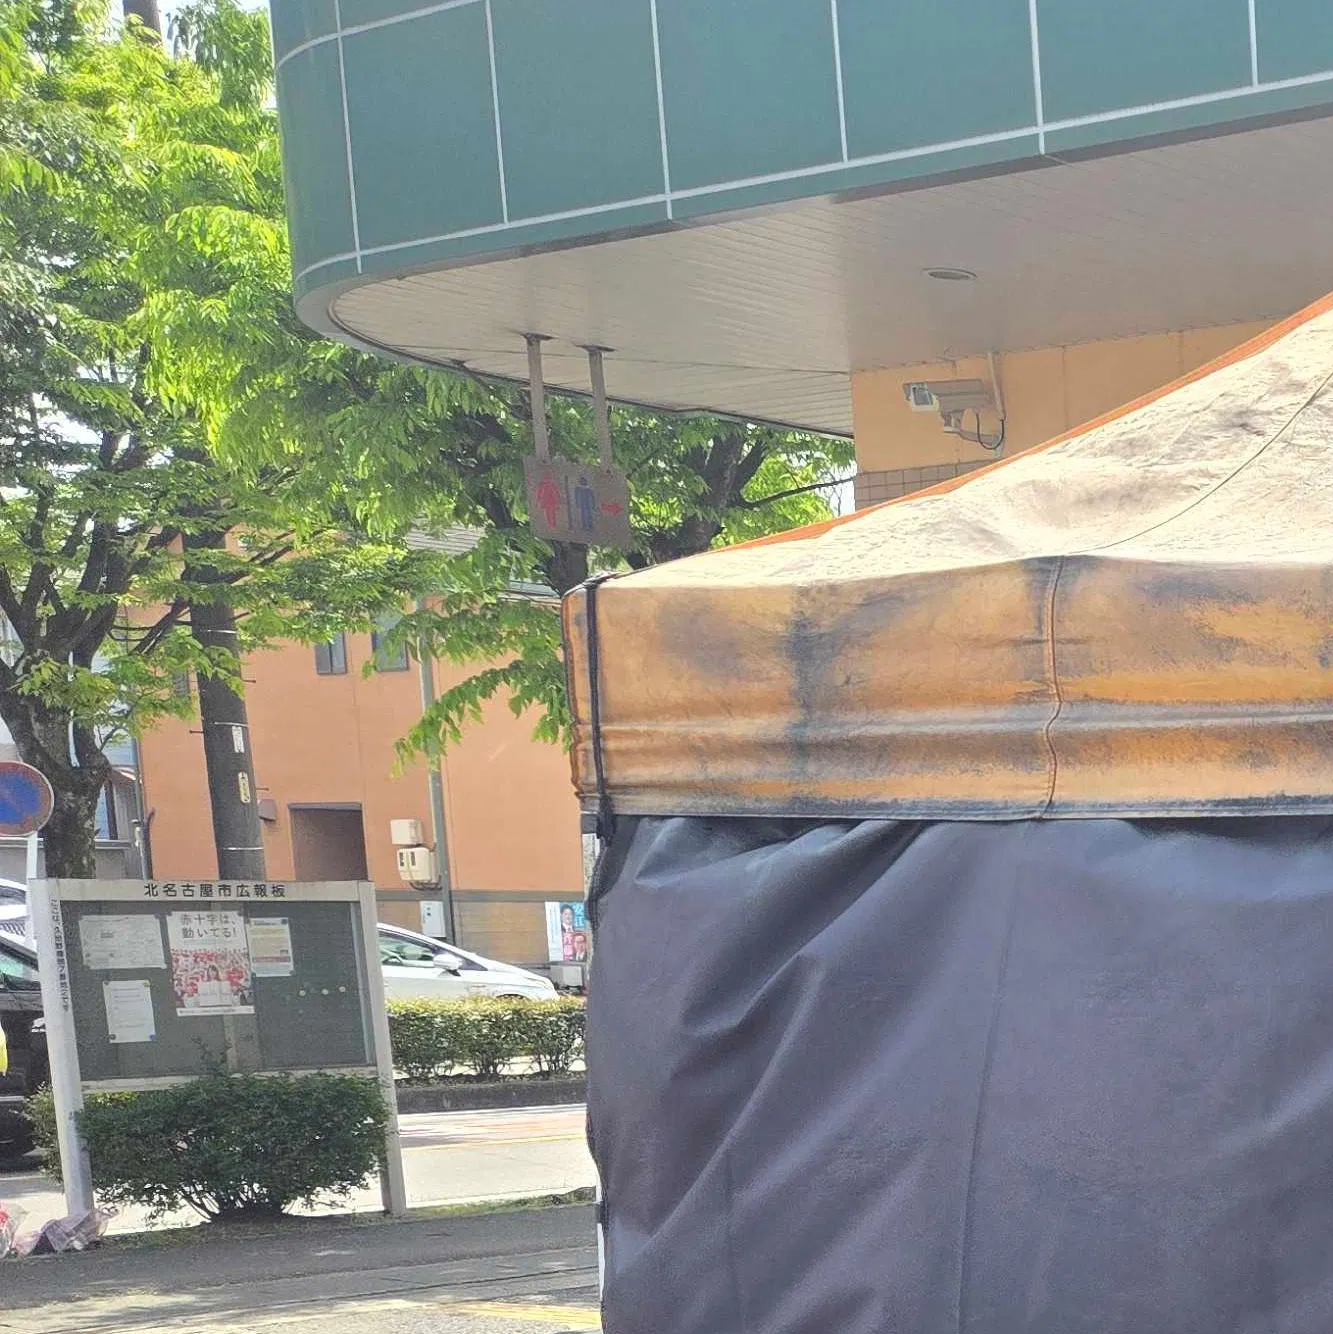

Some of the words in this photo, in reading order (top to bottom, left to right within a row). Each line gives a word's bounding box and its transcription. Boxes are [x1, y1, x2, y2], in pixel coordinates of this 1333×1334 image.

[144, 883, 287, 898] 北名古屋市広報板
